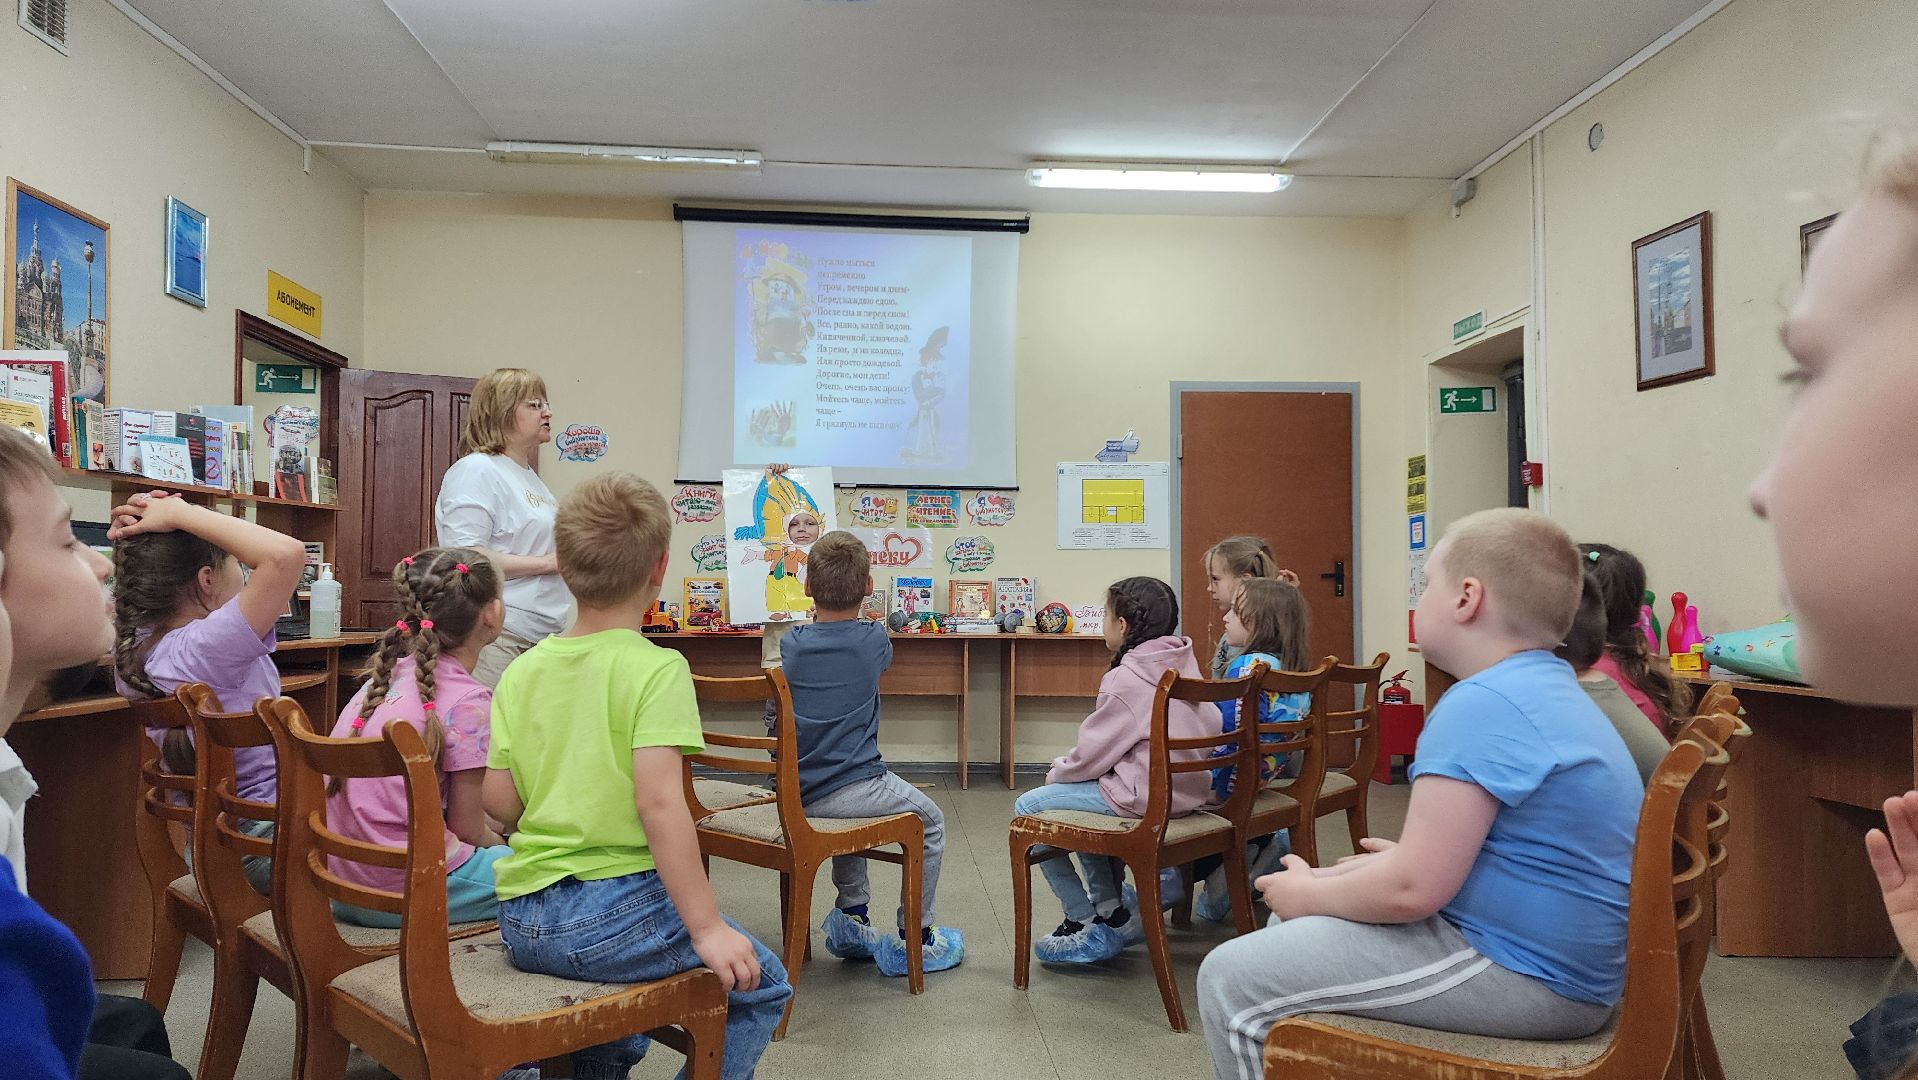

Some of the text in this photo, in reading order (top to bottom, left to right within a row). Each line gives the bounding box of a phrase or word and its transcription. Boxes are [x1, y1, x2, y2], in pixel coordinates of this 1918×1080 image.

[276, 289, 316, 317] АБОНЕМЕНТ
[817, 294, 842, 306] Перед
[817, 306, 841, 316] После
[842, 309, 855, 317] сна
[863, 310, 887, 320] перед
[860, 321, 884, 330] какой
[816, 356, 833, 366] Или
[834, 358, 862, 369] просто
[852, 372, 868, 380] мои
[868, 370, 890, 381] дети!
[868, 384, 882, 392] вас
[858, 421, 868, 429] не
